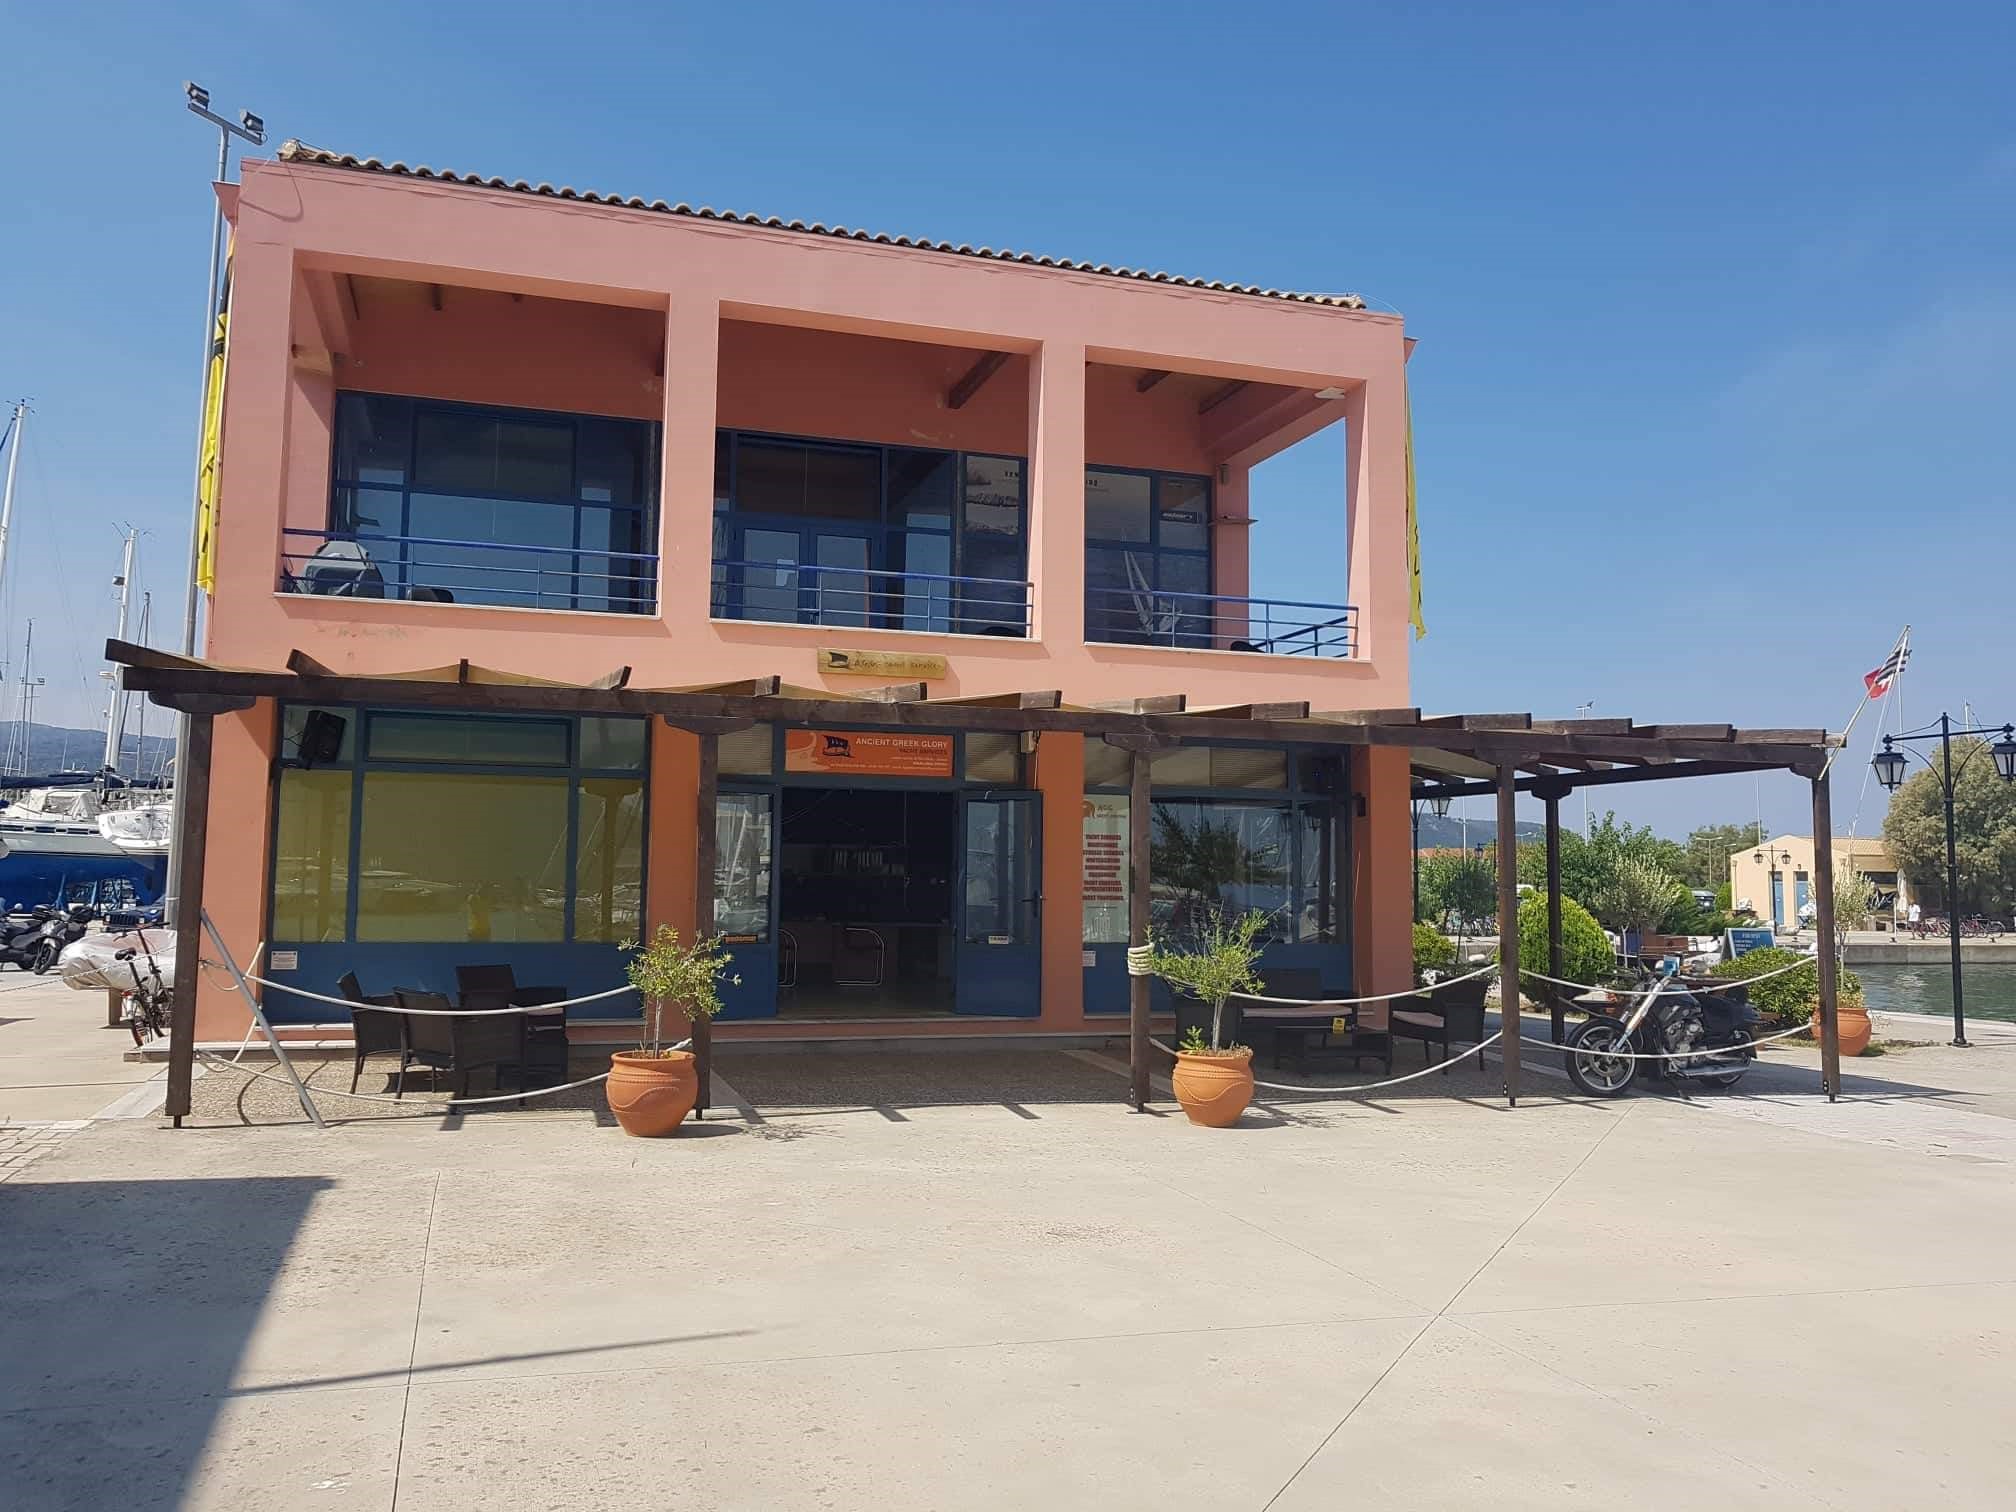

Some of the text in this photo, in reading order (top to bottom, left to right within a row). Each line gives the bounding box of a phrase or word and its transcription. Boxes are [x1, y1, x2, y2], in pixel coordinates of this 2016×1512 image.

[855, 737, 948, 749] ANCIENT GREEK GLORY
